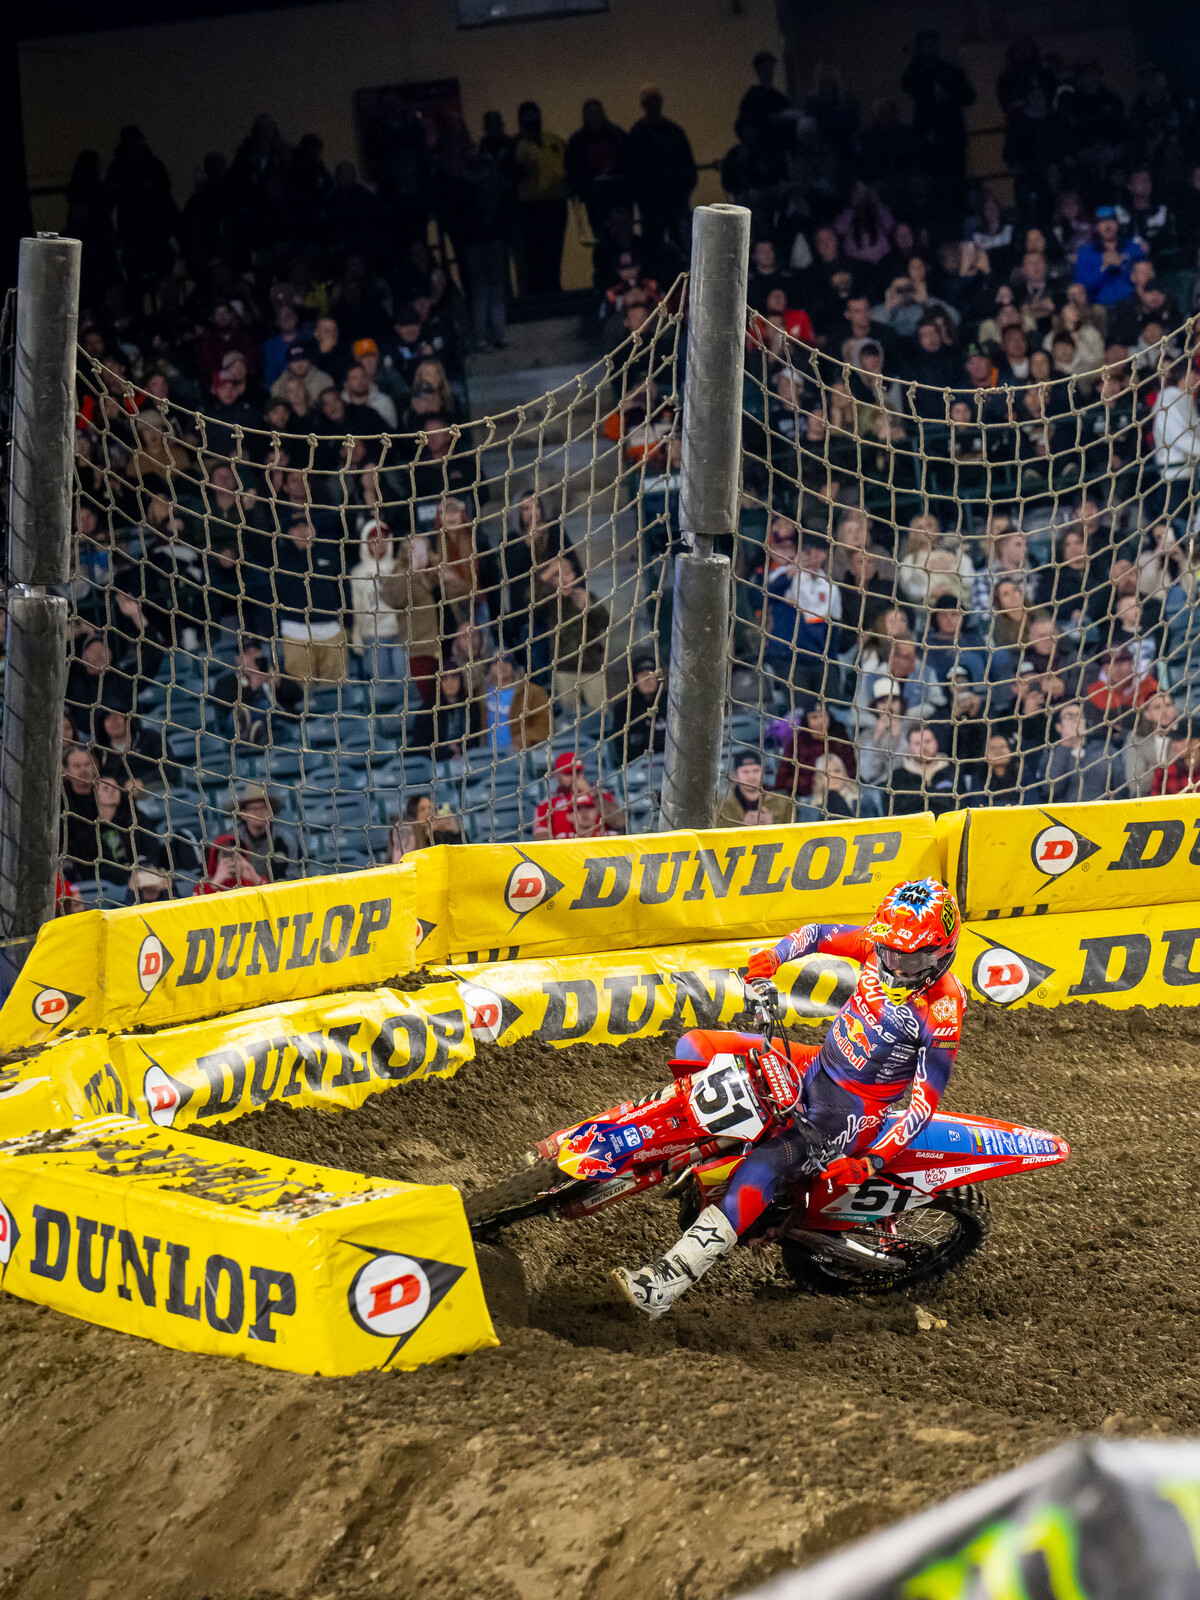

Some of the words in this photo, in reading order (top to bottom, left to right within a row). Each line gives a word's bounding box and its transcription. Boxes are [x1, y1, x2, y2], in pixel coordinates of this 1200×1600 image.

[1041, 841, 1074, 859] D
[511, 876, 543, 899] D
[569, 831, 902, 911] DUNLOP
[143, 952, 162, 975] D
[176, 897, 391, 987] DUNLOP
[985, 961, 1024, 989] D
[40, 996, 65, 1015] D
[152, 1085, 177, 1111] D
[197, 1009, 464, 1118] DUNLOP
[842, 1040, 868, 1071] Bull
[694, 1066, 754, 1134] 51
[762, 1057, 785, 1106] RENTHAL
[1022, 1154, 1060, 1165] DUNLOP
[590, 1183, 628, 1205] DUNLOP
[851, 1177, 914, 1214] 51
[30, 1204, 296, 1343] DUNLOP
[368, 1273, 422, 1318] D
